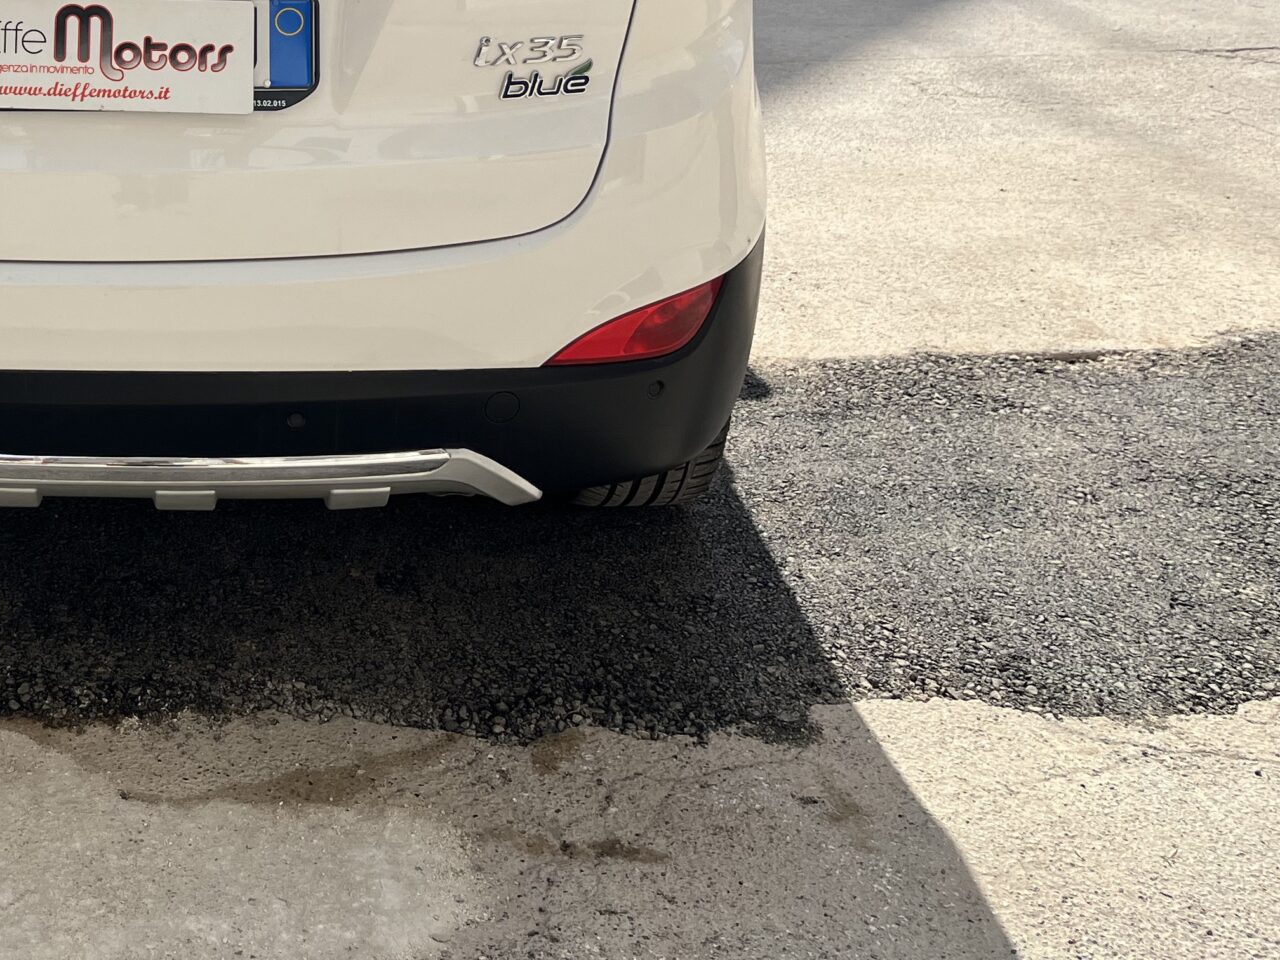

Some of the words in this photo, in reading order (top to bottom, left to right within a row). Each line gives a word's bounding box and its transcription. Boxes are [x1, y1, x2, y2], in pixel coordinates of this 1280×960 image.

[53, 3, 234, 82] Motors
[29, 62, 39, 74] in
[39, 63, 95, 75] movimento
[499, 71, 590, 100] blue
